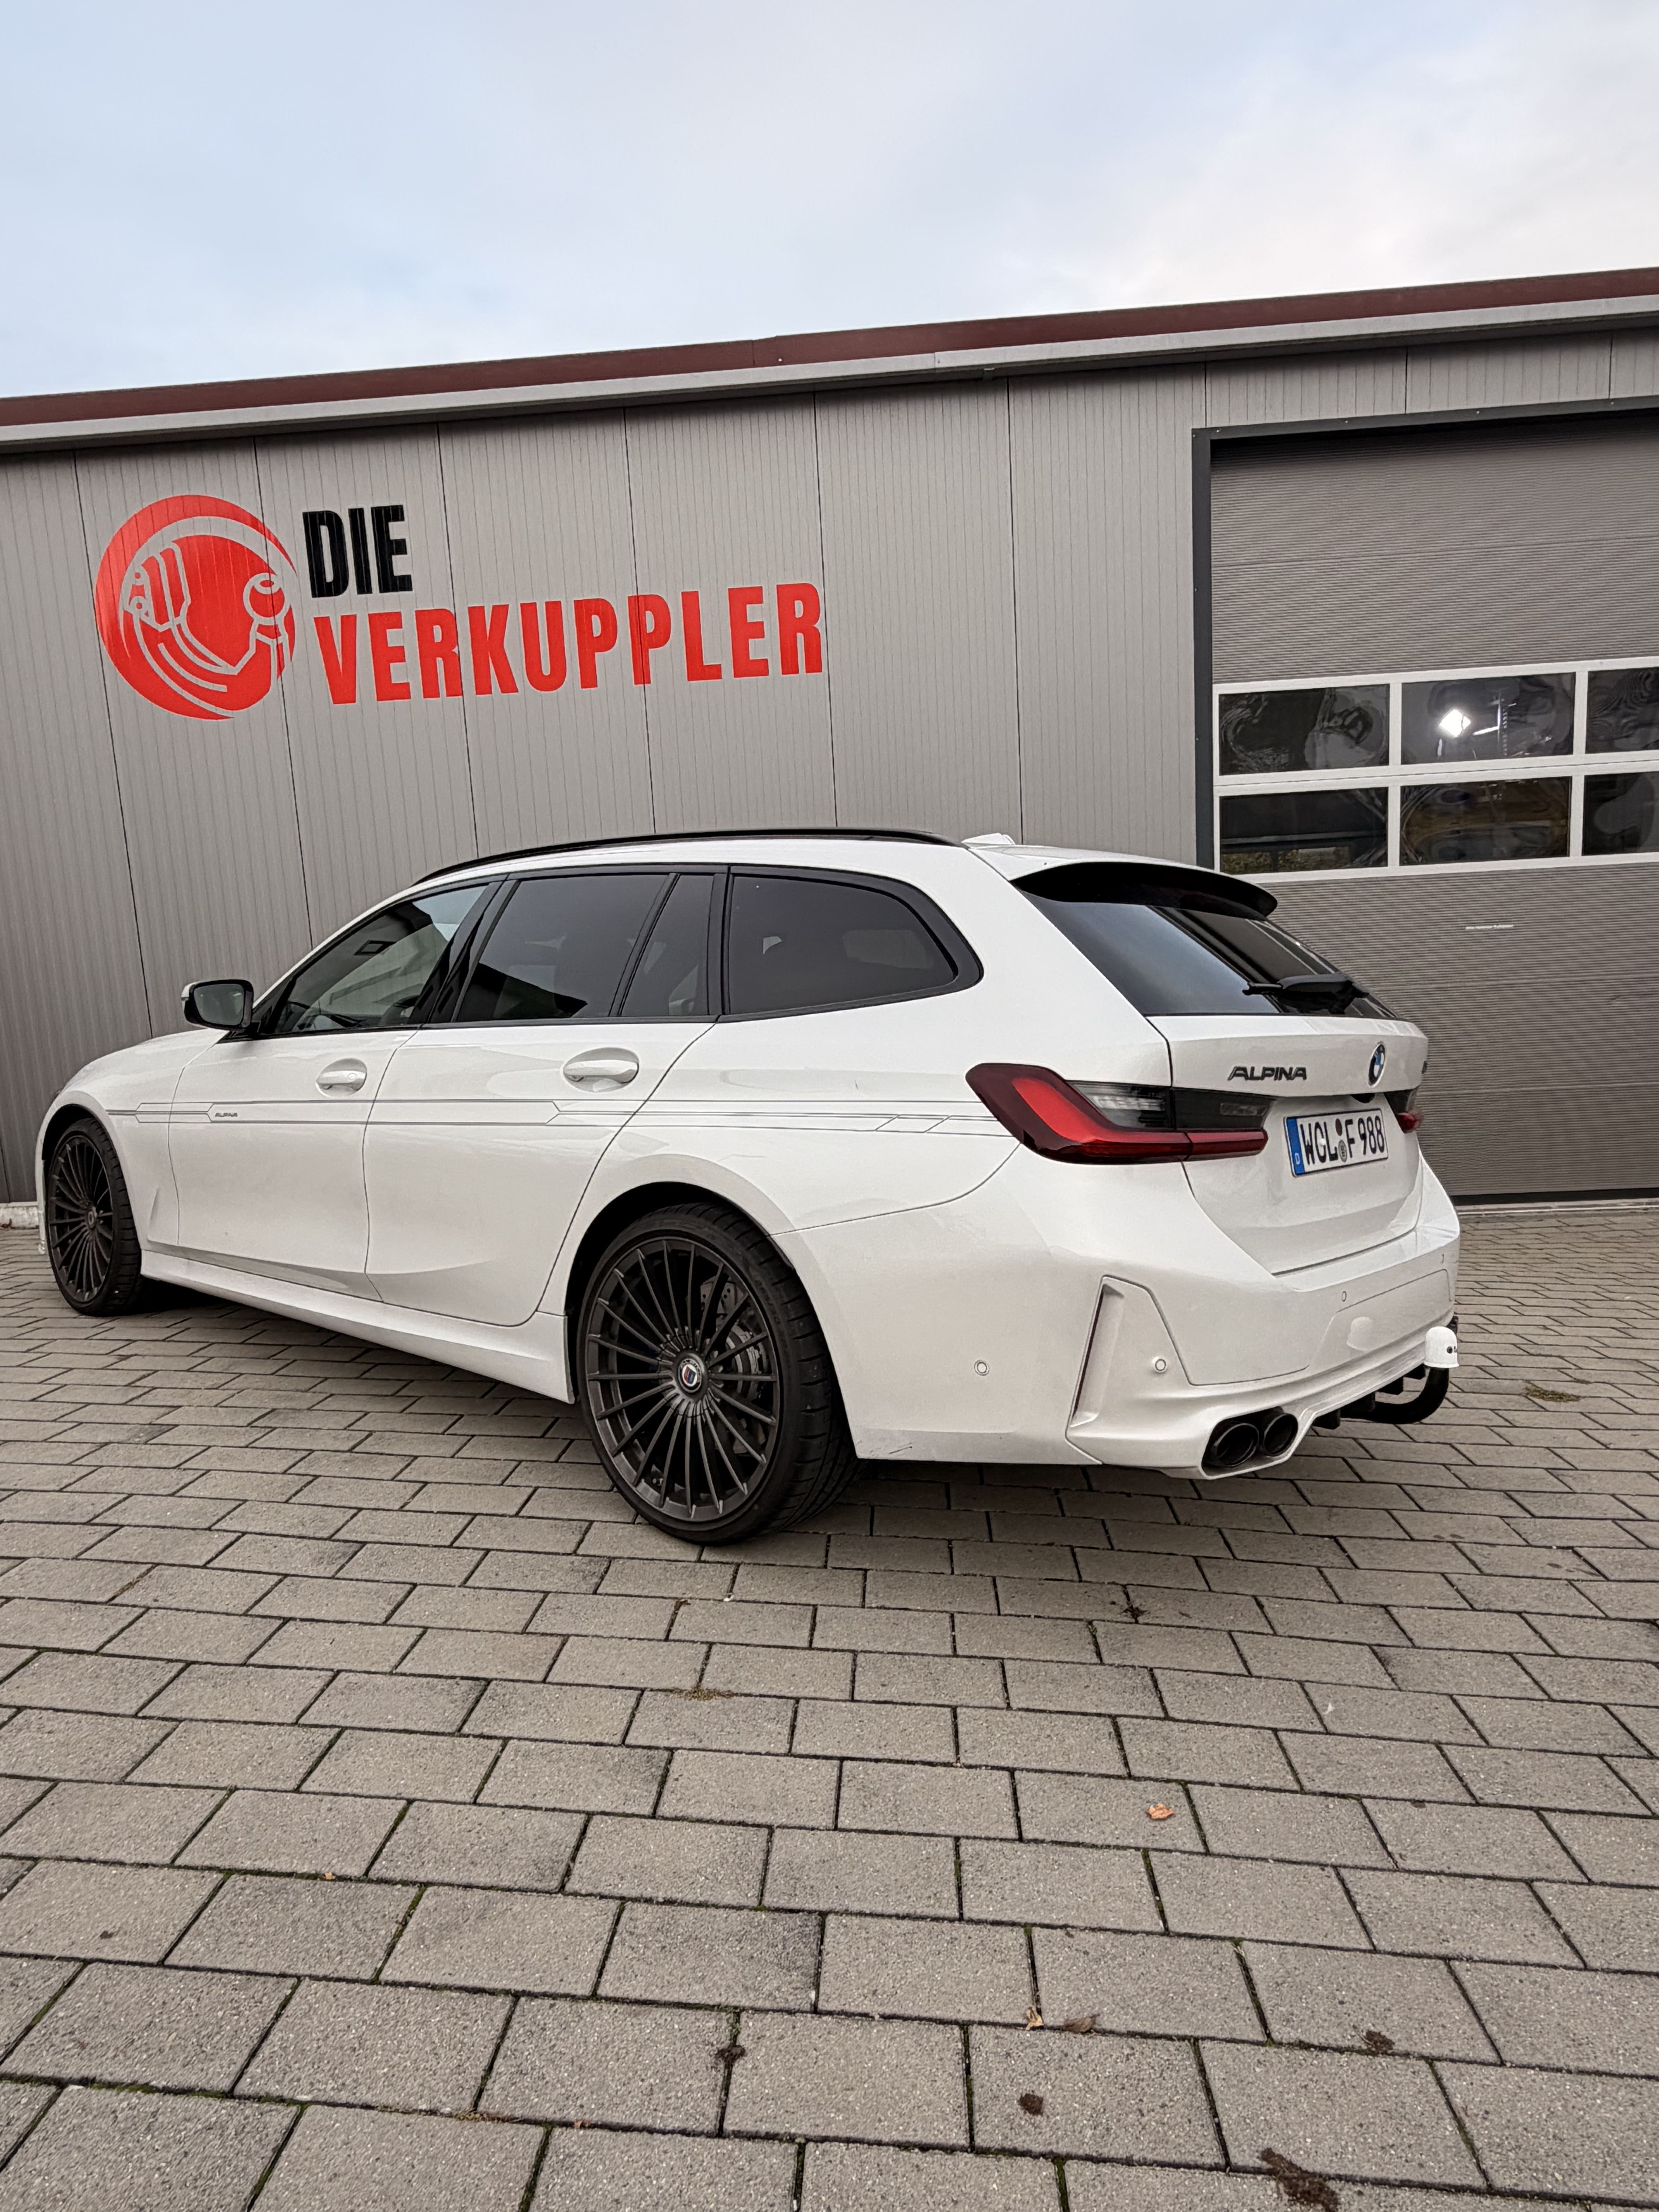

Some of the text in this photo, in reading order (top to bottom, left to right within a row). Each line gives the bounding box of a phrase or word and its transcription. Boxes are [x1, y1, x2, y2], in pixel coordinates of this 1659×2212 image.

[302, 505, 413, 598] DIE
[313, 583, 822, 705] VERKUPPLER
[1227, 1066, 1308, 1082] ALPINA
[1345, 1118, 1355, 1158] F
[1358, 1115, 1385, 1156] 988
